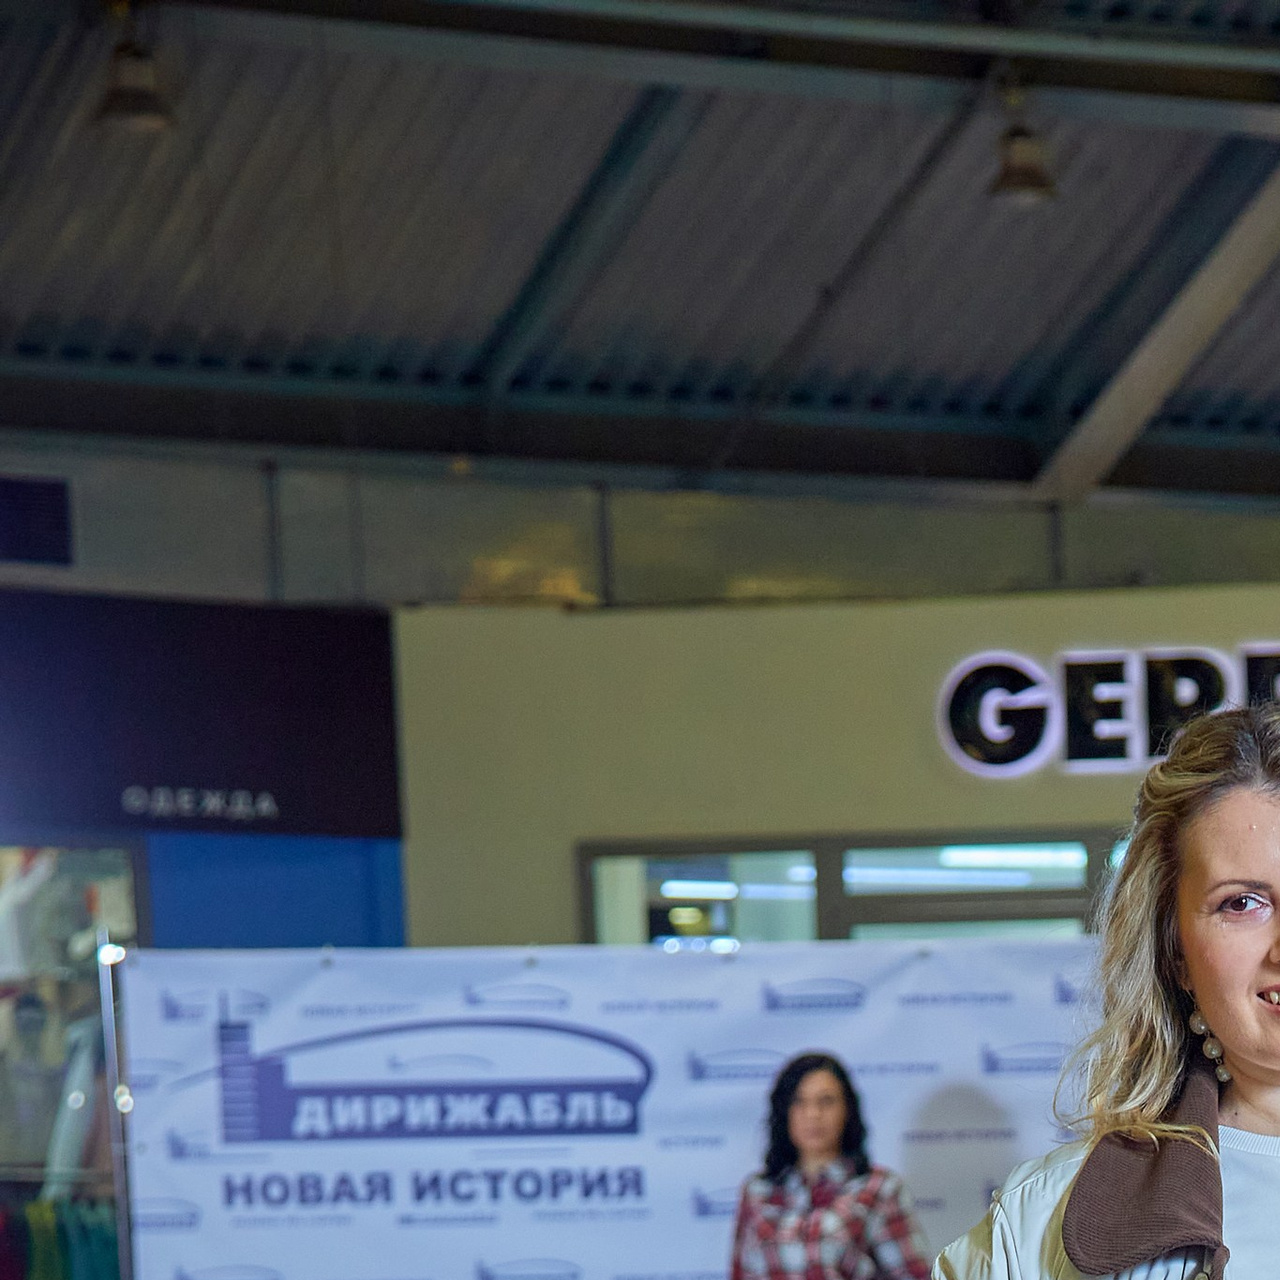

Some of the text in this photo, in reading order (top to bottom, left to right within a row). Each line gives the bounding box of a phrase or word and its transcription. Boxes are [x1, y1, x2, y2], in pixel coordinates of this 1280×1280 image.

[121, 786, 280, 820] ОДЕЖДА
[291, 1090, 635, 1138] ДИРИЖАБЛЬ
[222, 1165, 646, 1208] НОВАЯ ИСТОРИЯ
